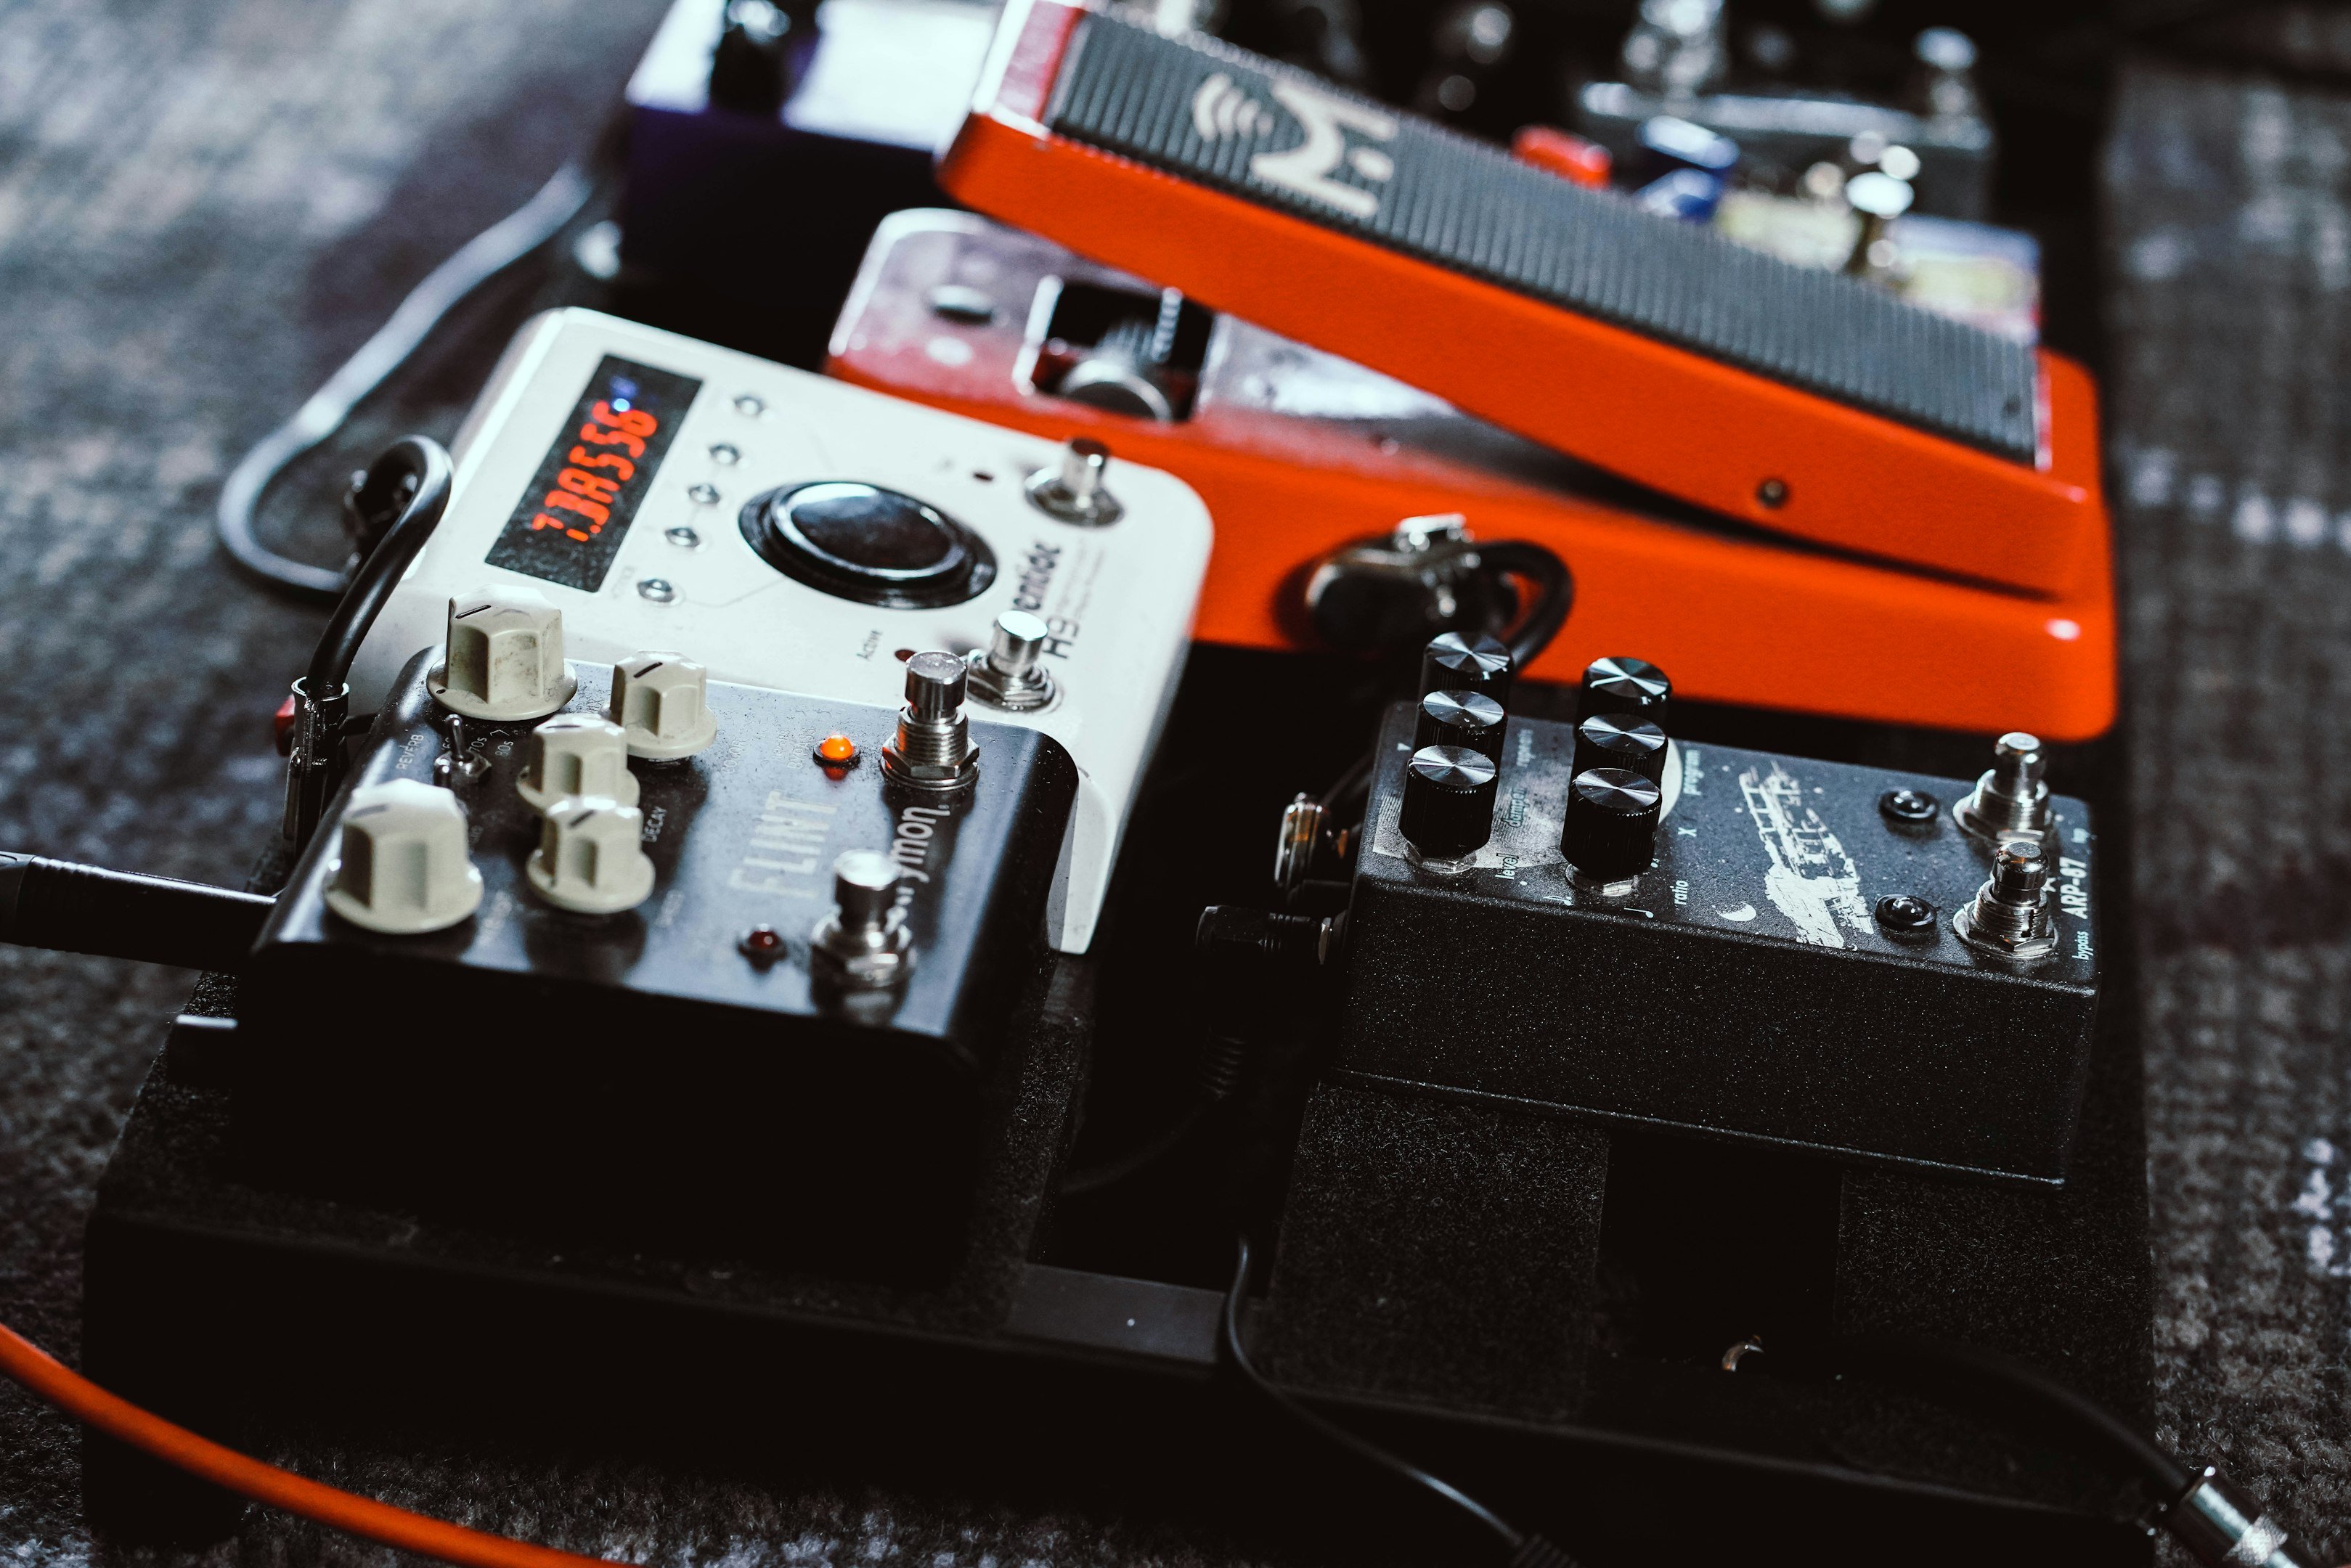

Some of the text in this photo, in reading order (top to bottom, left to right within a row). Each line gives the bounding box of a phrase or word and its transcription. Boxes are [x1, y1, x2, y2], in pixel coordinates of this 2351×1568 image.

[1043, 616, 1079, 659] H9
[396, 735, 424, 770] REVERB
[787, 727, 816, 769] BYPASS
[642, 806, 667, 843] DECAY
[729, 789, 837, 899] FLINT
[890, 807, 950, 905] ymon
[1495, 853, 1519, 881] level
[1670, 880, 1690, 906] ratio
[2059, 857, 2088, 920] ARP-87
[2071, 931, 2094, 961] bypass
